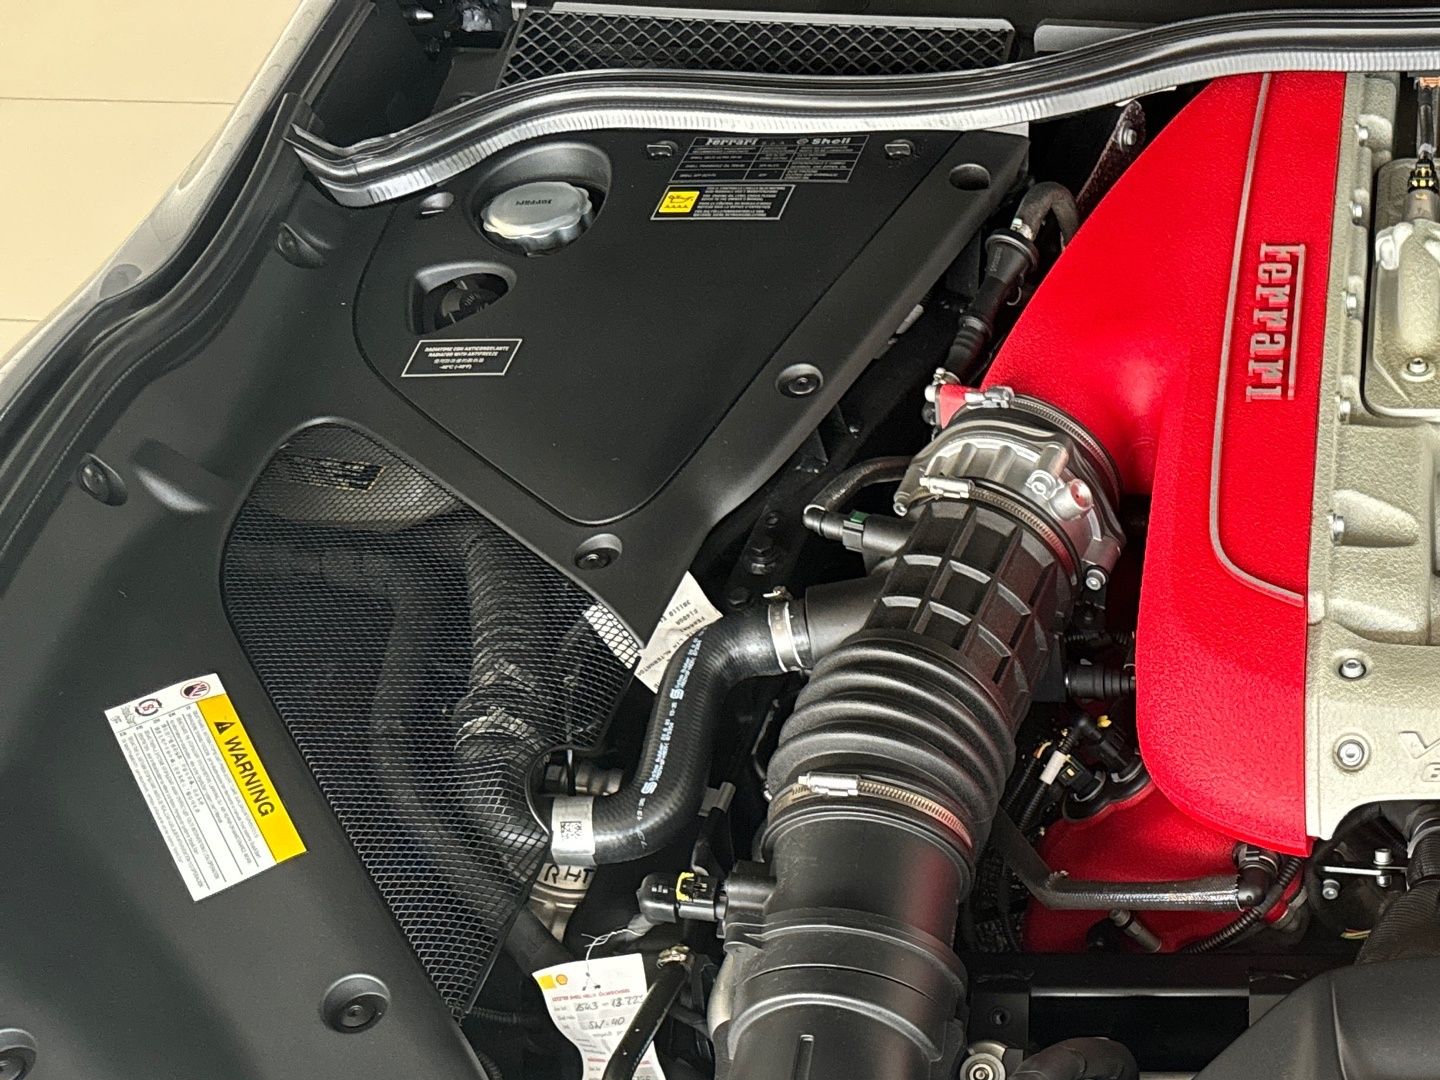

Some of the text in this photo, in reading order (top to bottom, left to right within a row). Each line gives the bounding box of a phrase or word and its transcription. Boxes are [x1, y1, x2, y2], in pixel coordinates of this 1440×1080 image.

[704, 136, 759, 147] Ferrari
[811, 137, 852, 146] Shell
[1246, 241, 1306, 403] Ferrari
[224, 735, 276, 817] WARNING
